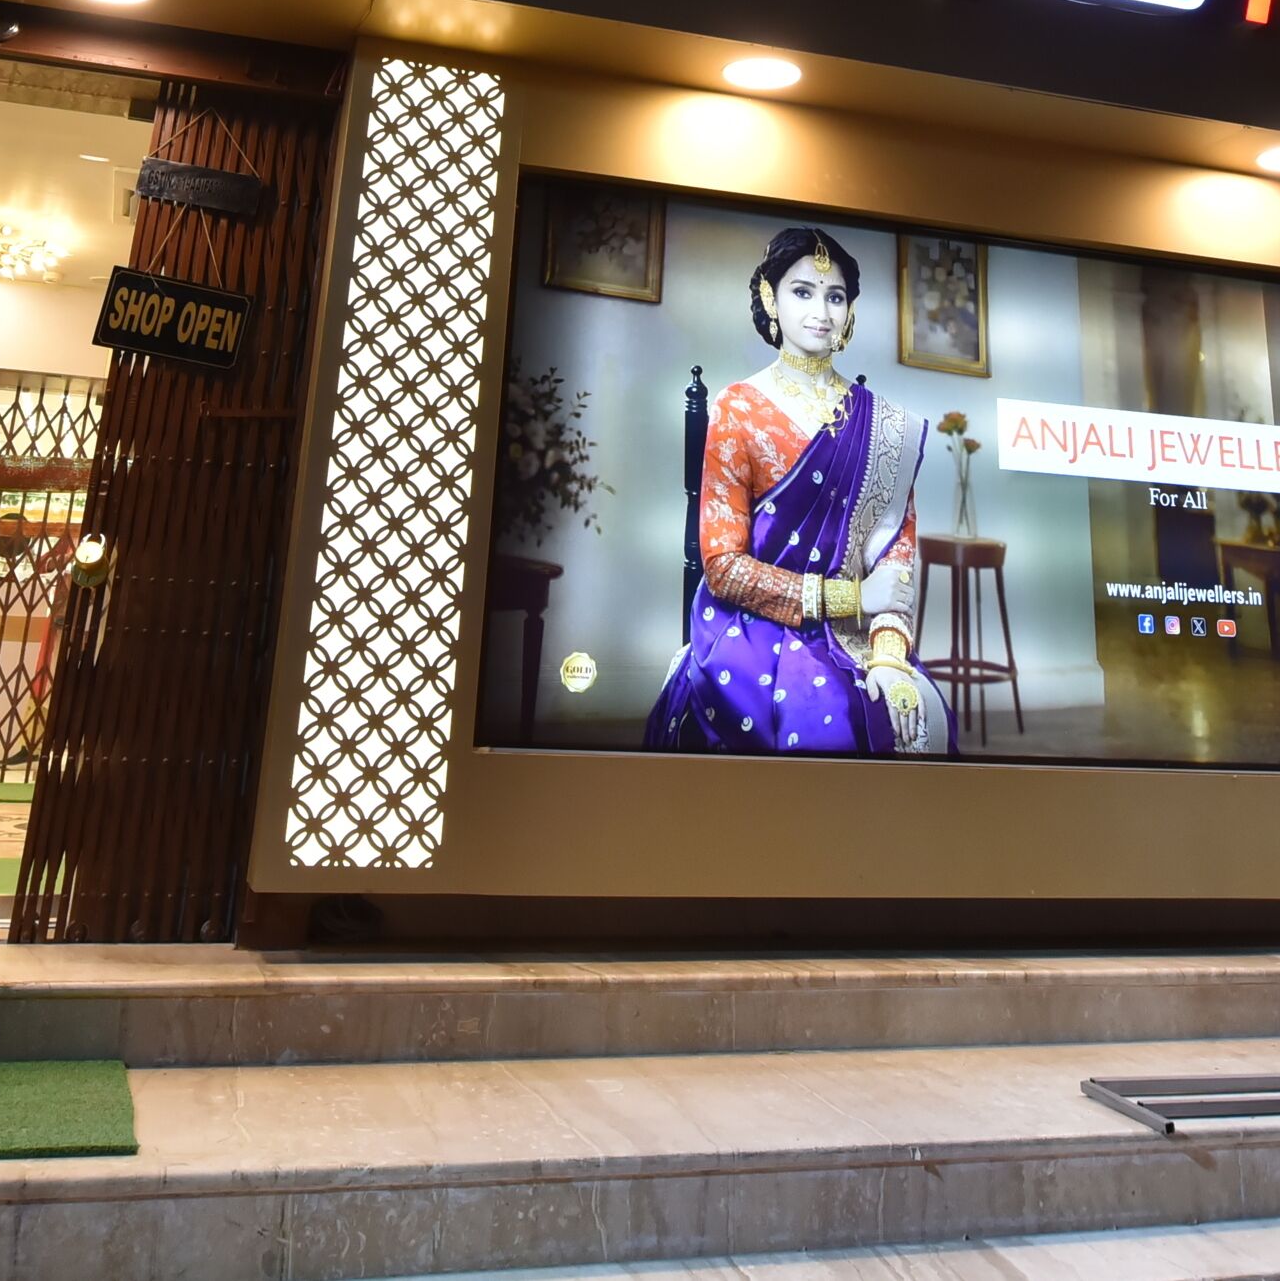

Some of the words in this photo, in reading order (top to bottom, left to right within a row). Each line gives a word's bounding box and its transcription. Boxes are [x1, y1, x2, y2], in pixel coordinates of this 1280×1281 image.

[109, 287, 175, 338] SHOP
[176, 301, 242, 353] OPEN
[1012, 417, 1134, 464] ANJALI
[1148, 487, 1178, 508] For
[1182, 491, 1208, 510] All
[1106, 581, 1262, 606] www.anjalijewellers.in
